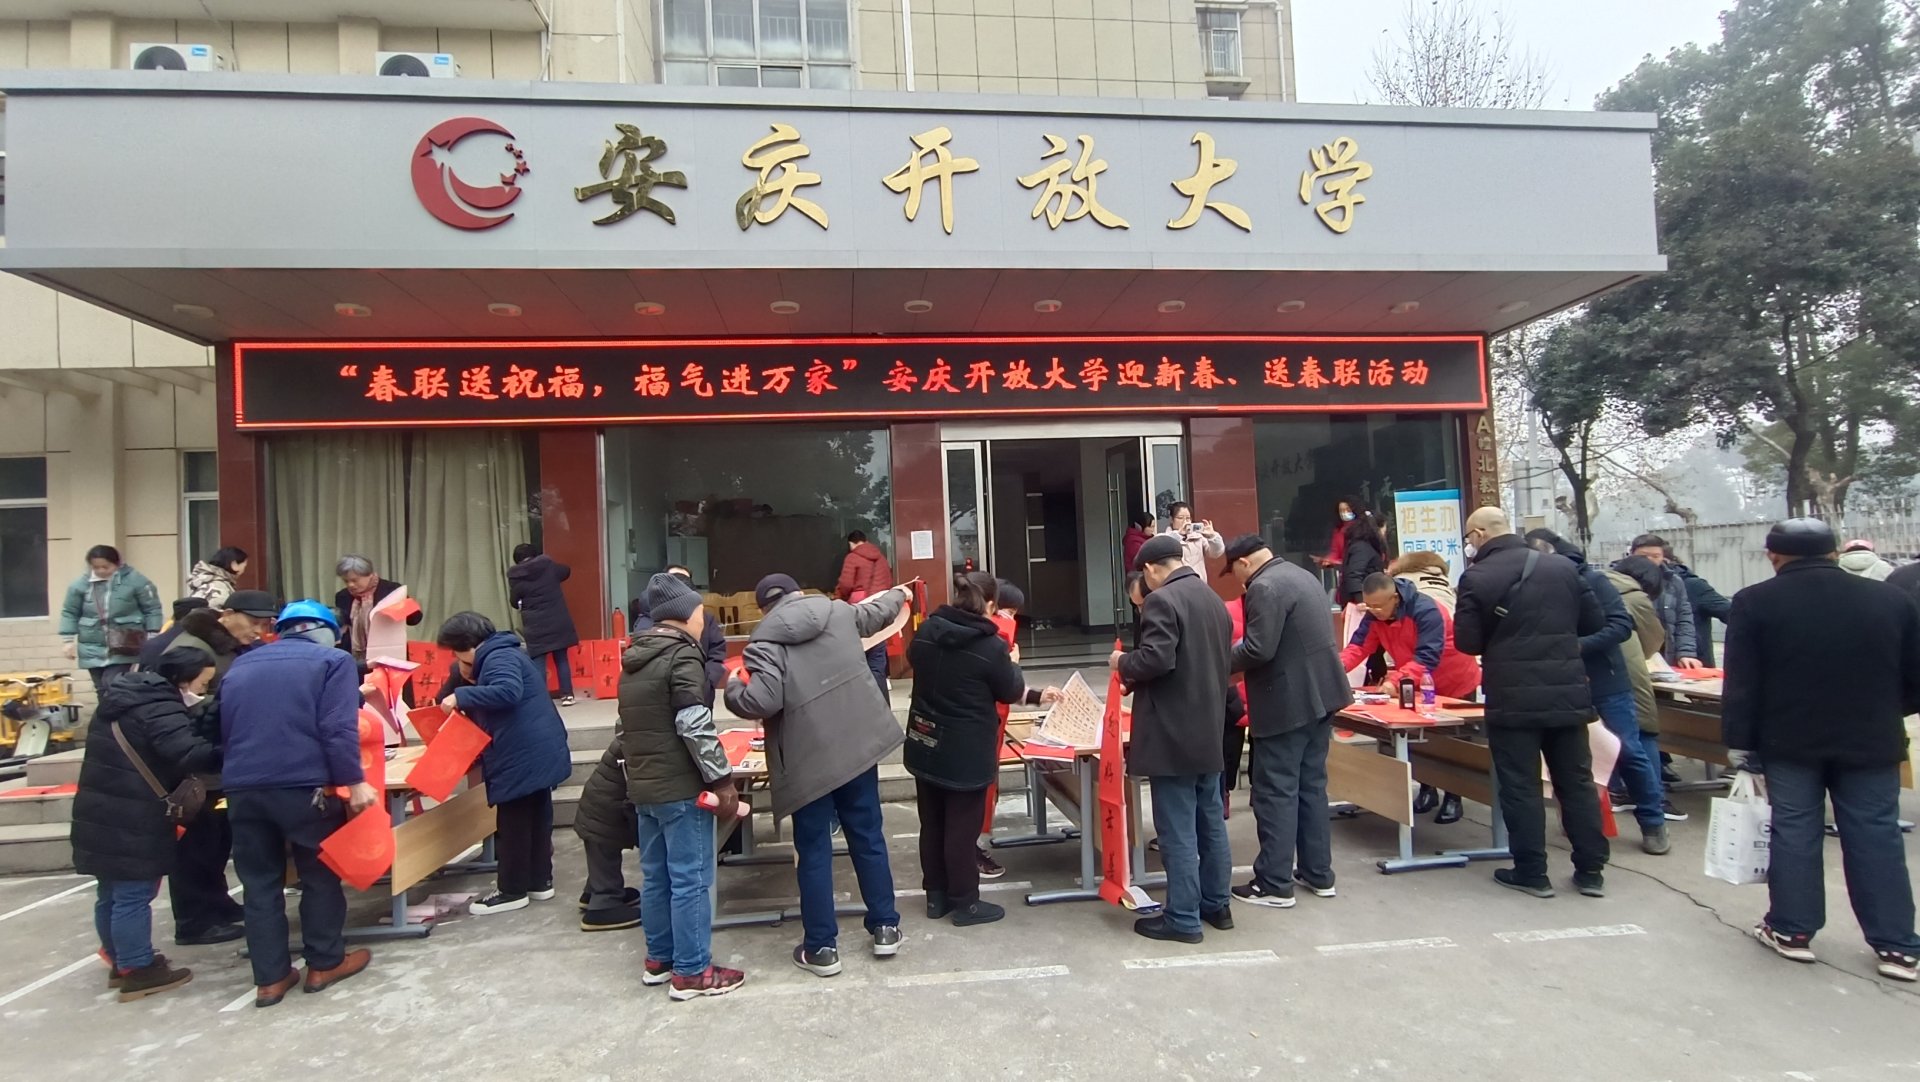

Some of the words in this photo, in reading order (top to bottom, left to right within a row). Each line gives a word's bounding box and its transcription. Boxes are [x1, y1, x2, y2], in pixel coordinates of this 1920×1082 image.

[575, 124, 1375, 234] 安庆开放大学
[1401, 505, 1456, 534] 招生办
